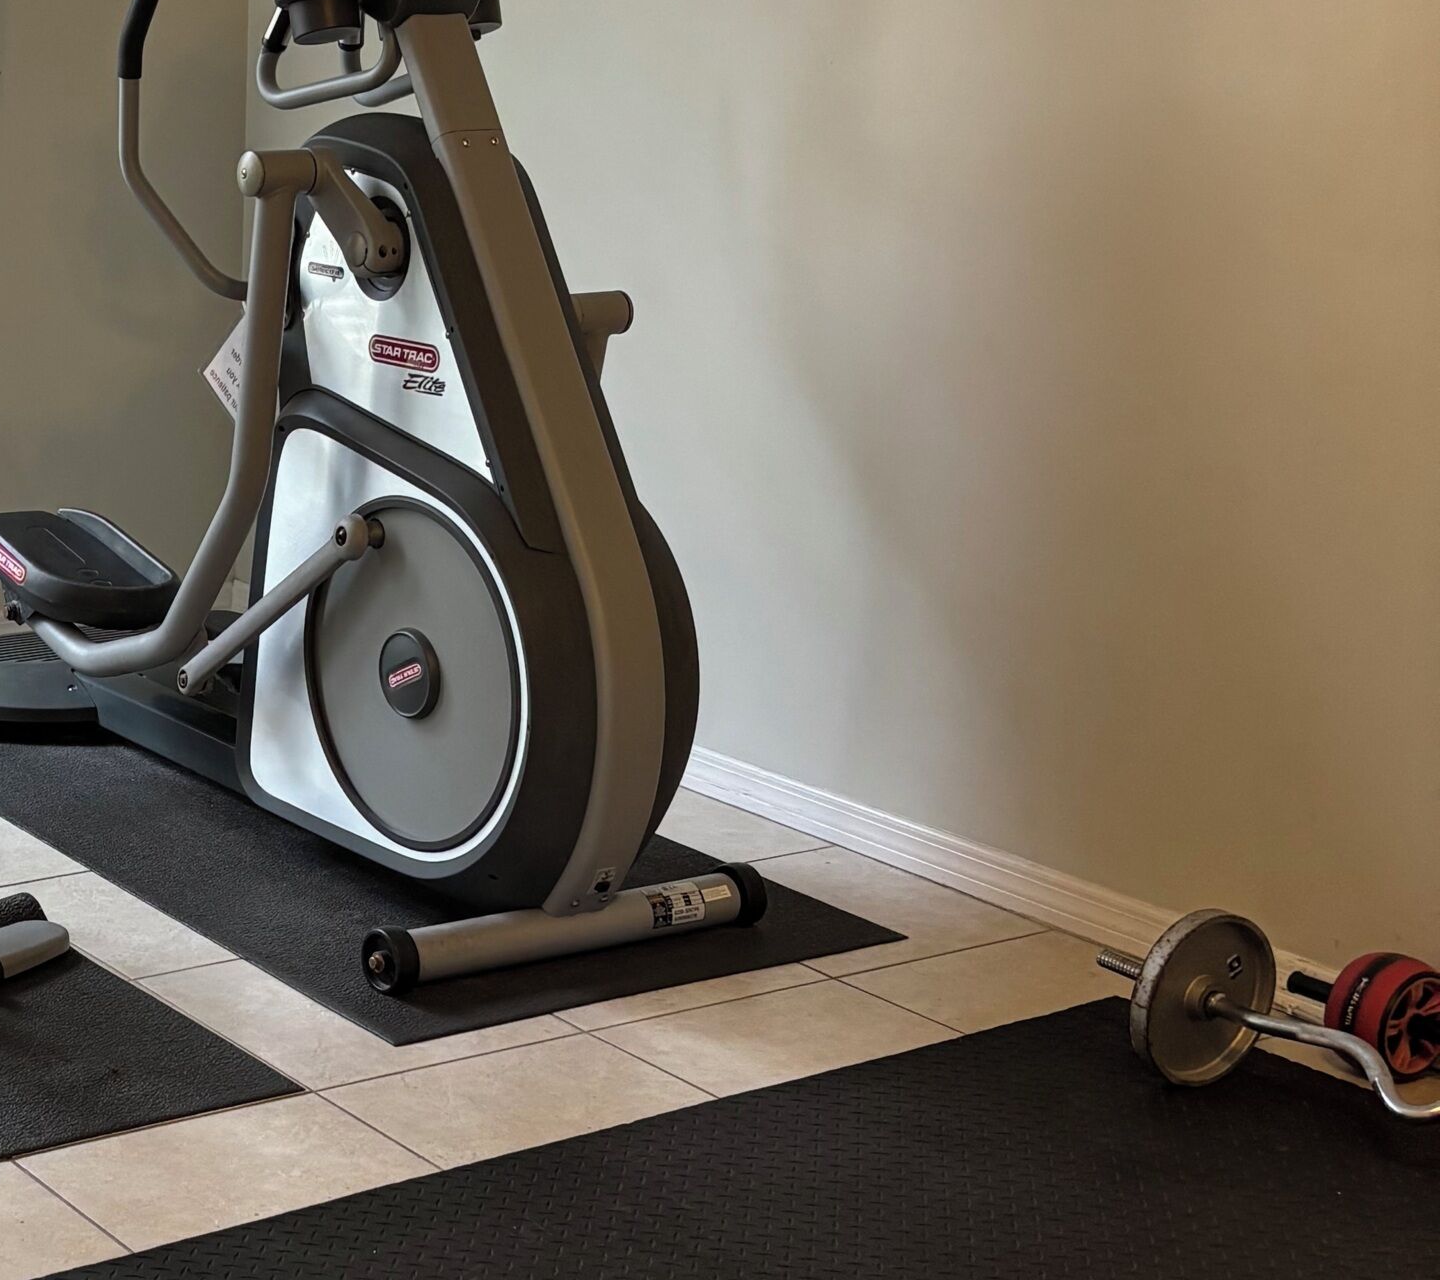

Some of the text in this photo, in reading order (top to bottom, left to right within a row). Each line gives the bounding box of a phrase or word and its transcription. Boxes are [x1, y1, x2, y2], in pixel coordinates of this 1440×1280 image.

[372, 343, 433, 364] STAR TRAC
[402, 373, 446, 394] Elite
